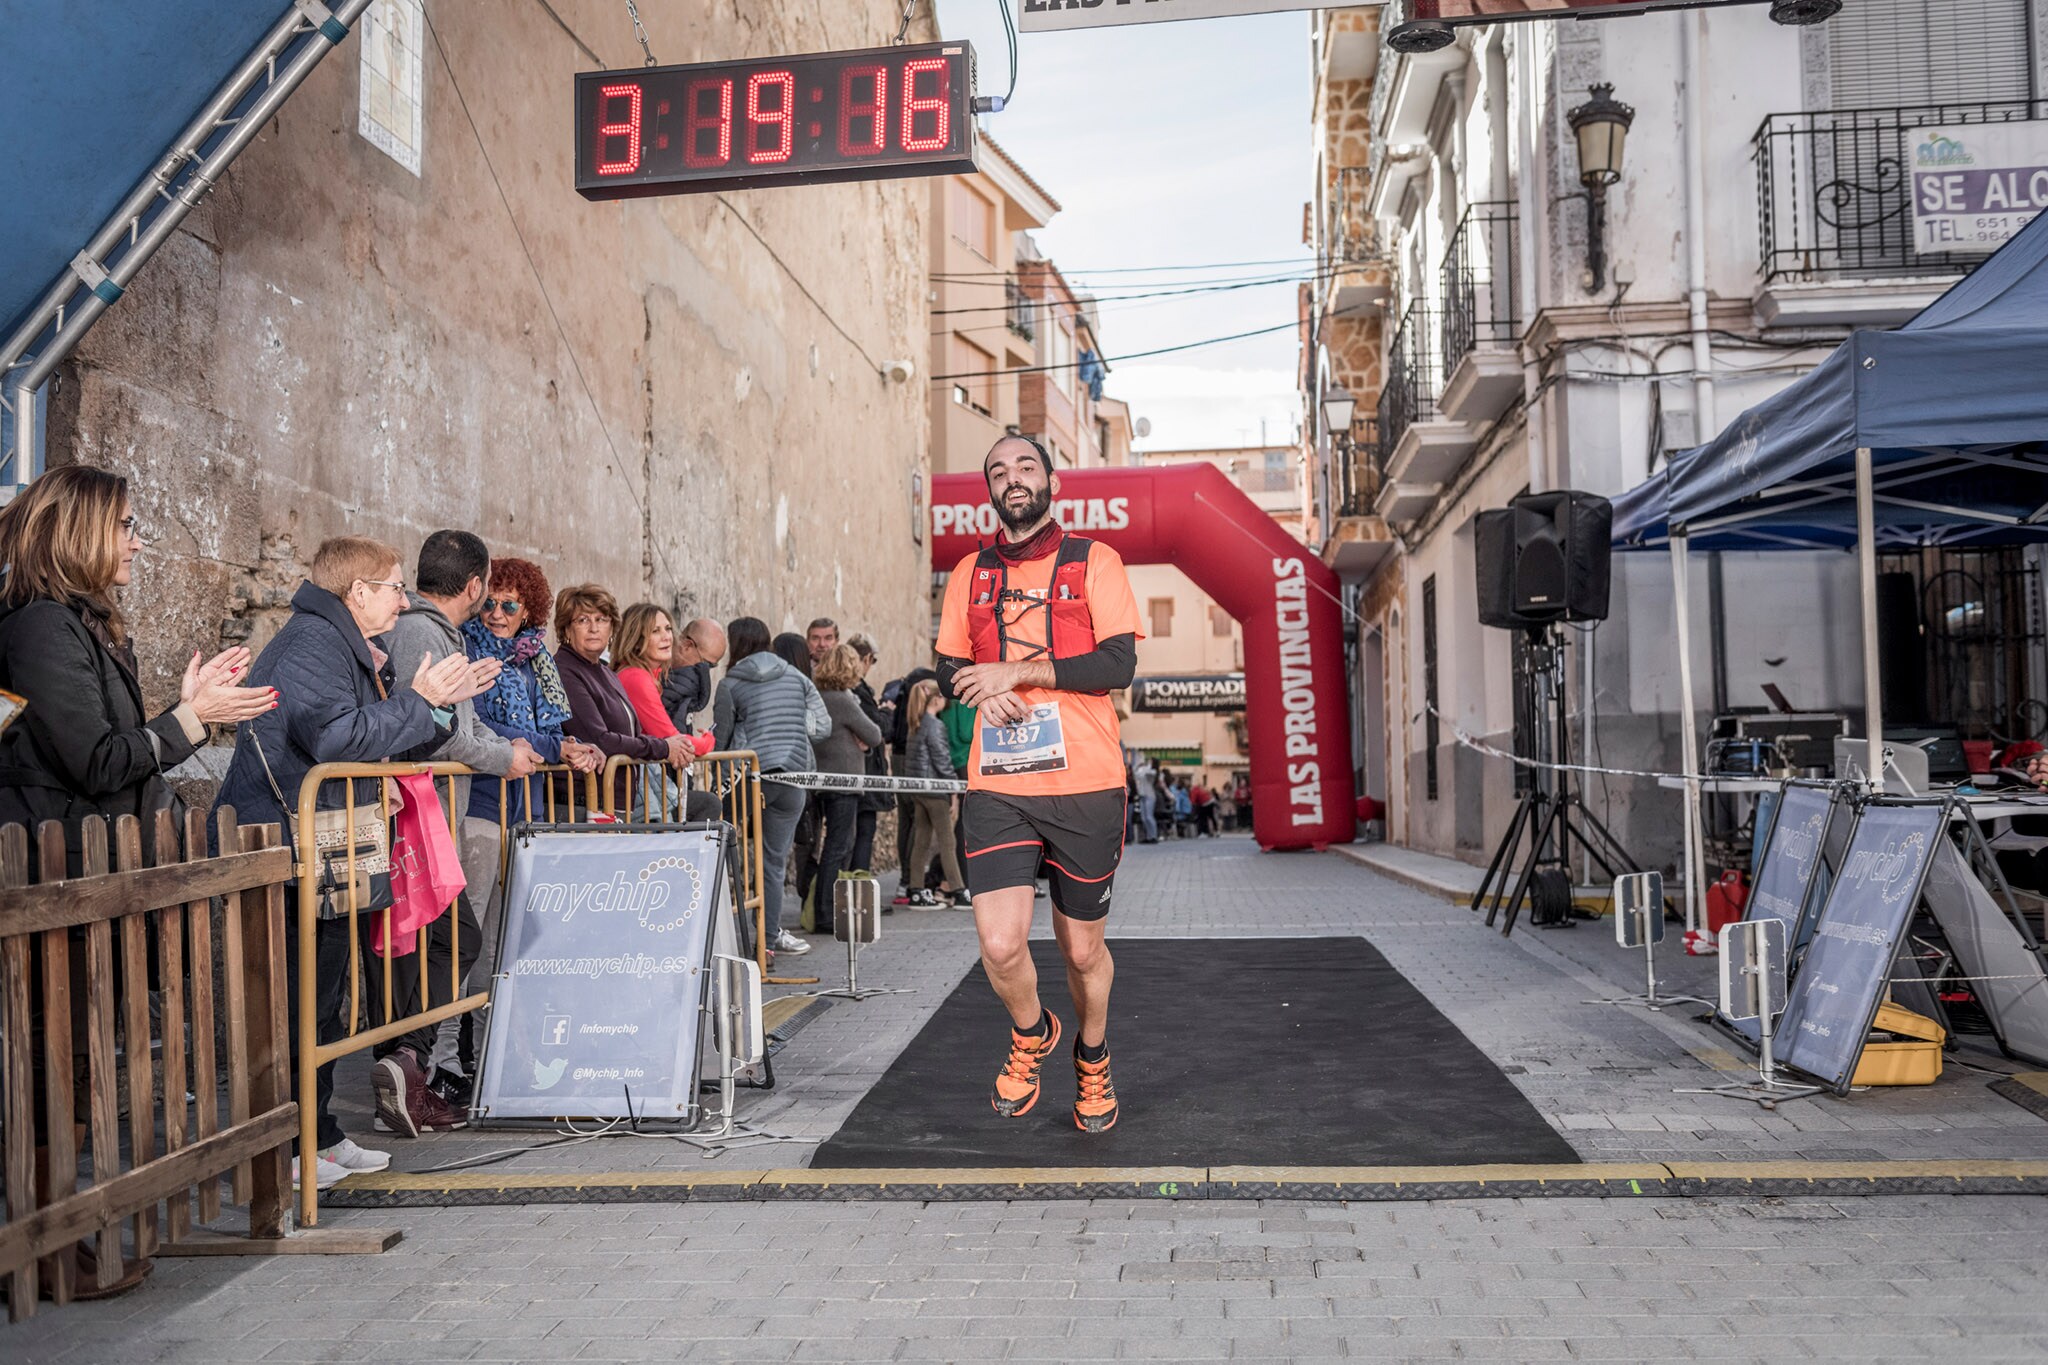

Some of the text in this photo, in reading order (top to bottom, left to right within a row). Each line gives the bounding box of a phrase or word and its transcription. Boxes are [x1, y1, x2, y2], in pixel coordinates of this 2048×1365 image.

[1921, 175, 1966, 211] SE
[1976, 217, 2008, 229] 651
[1977, 231, 2010, 242] 964
[1273, 557, 1323, 826] LAS PROVINCIAS
[996, 725, 1040, 746] 1287
[526, 870, 671, 922] mychip
[515, 953, 689, 979] www.mychip.es
[579, 1023, 639, 1036] /infomychip
[572, 1067, 644, 1081] @Mychip_Info
